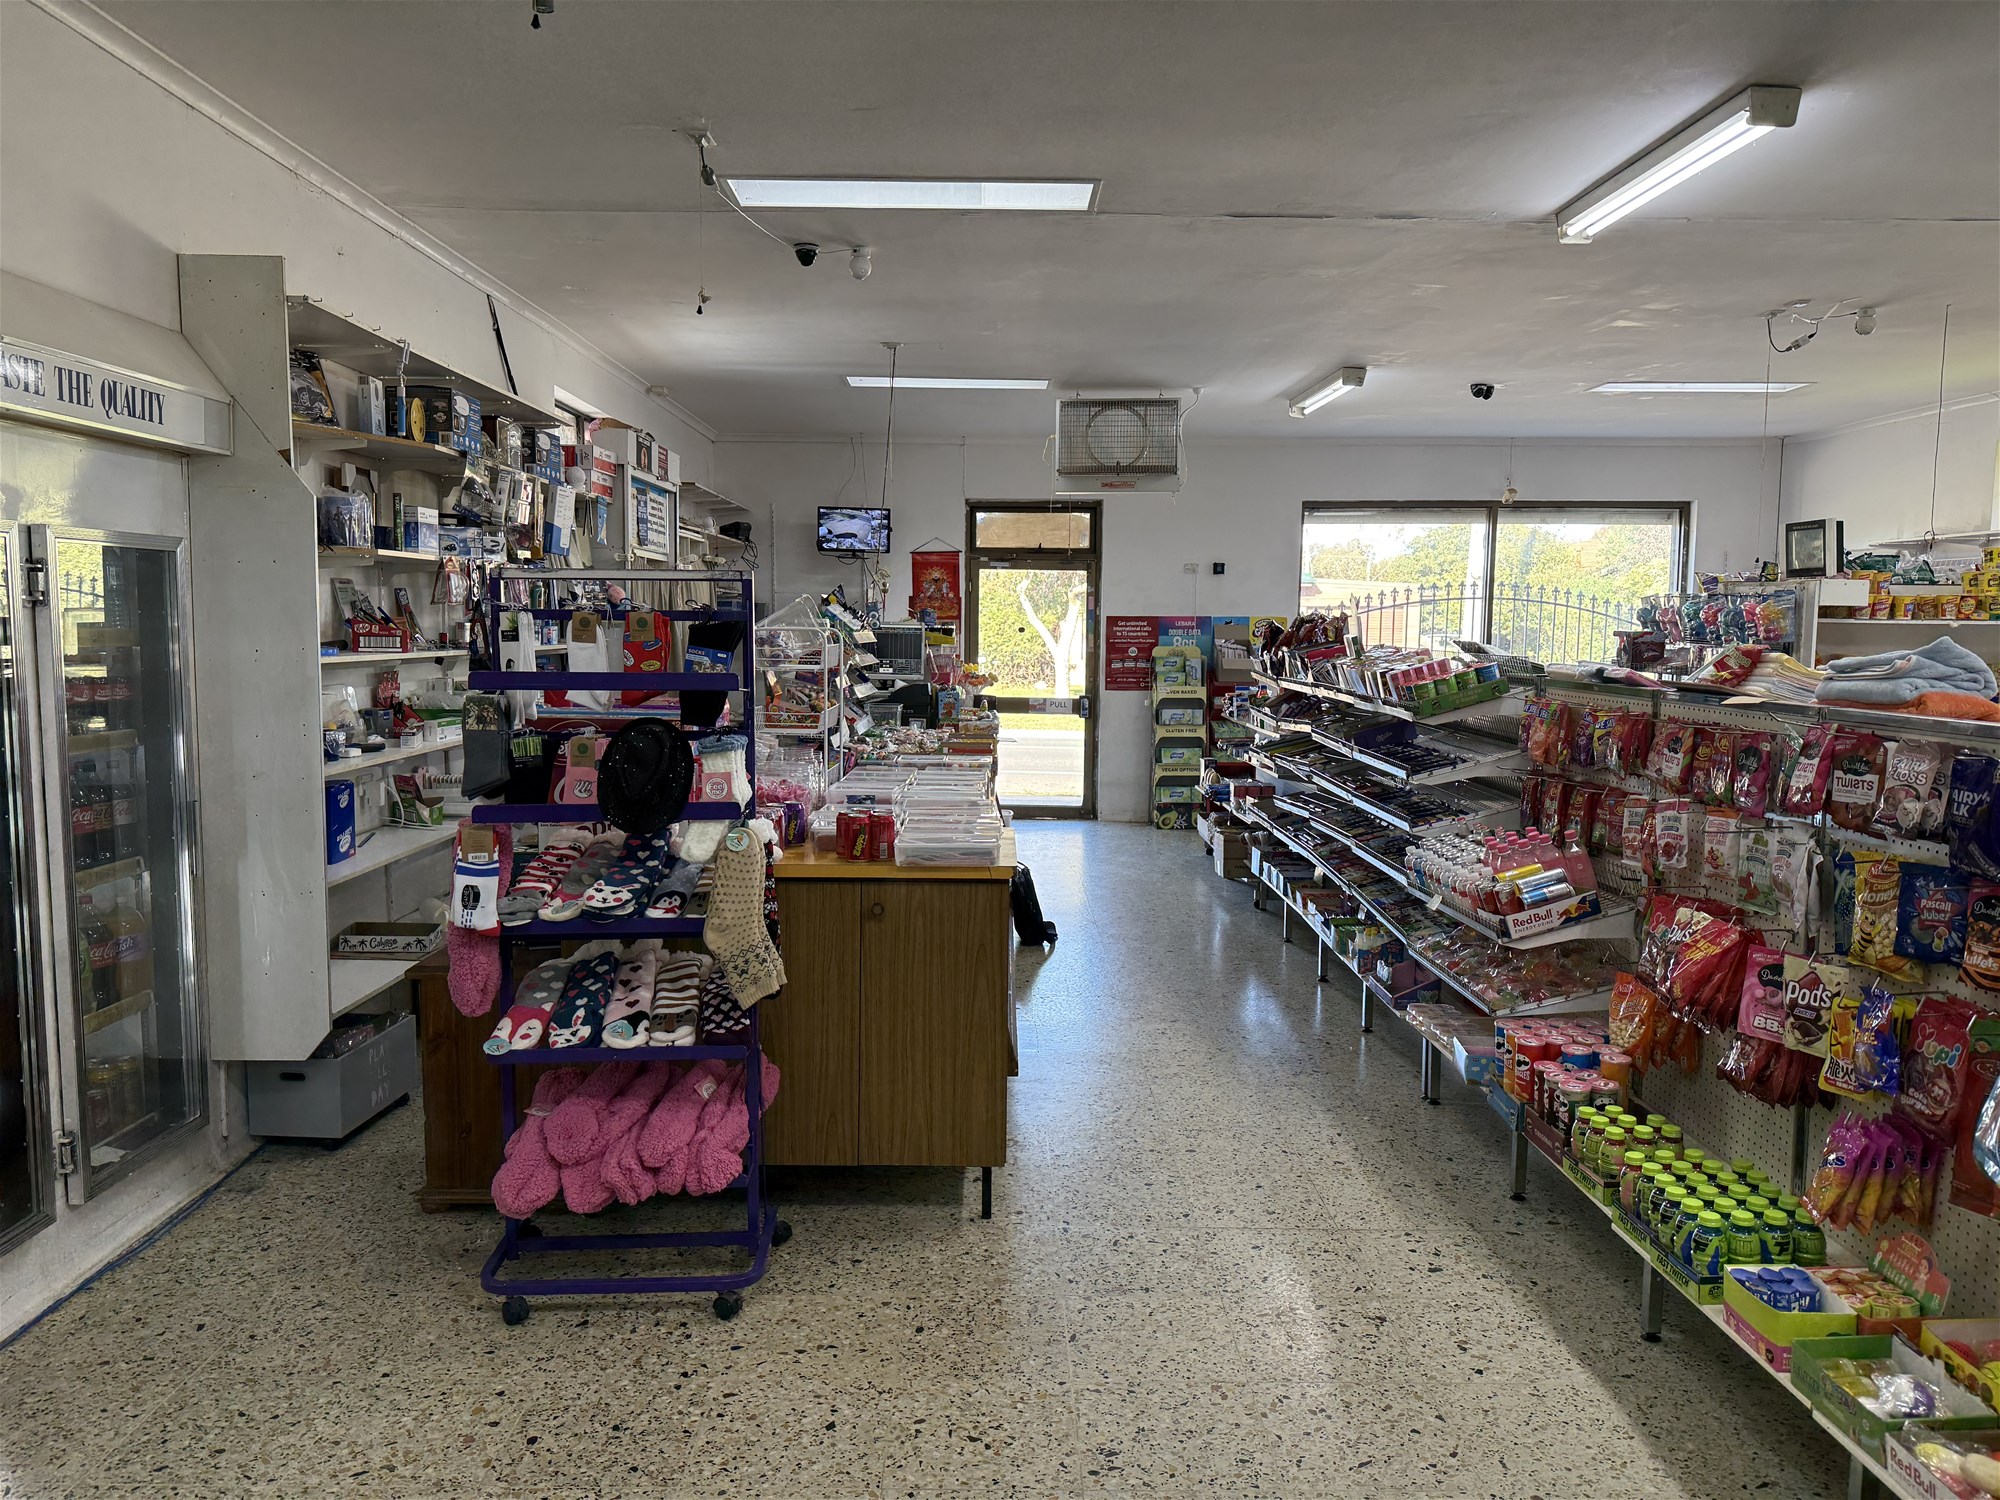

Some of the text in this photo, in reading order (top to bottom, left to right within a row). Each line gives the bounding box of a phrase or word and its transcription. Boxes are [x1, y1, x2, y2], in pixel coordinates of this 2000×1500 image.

[53, 365, 94, 409] THE
[100, 376, 167, 426] QUALITY
[1168, 628, 1188, 636] DOUBLE
[1050, 700, 1067, 708] PULL
[1893, 757, 1928, 772] FAIRY
[1835, 776, 1874, 792] TWISTS
[1891, 768, 1927, 785] FLOSS
[1920, 898, 1951, 912] Pascall
[1512, 909, 1552, 929] Red Bull
[1920, 910, 1950, 921] Jubes
[1515, 920, 1555, 934] ENERGY DRINK
[1568, 1163, 1597, 1191] FAST TWITCH
[1618, 1212, 1648, 1242] FAST TWITCH
[1656, 1253, 1690, 1288] FAST TWITCH
[1890, 1446, 1937, 1500] Red Bull
